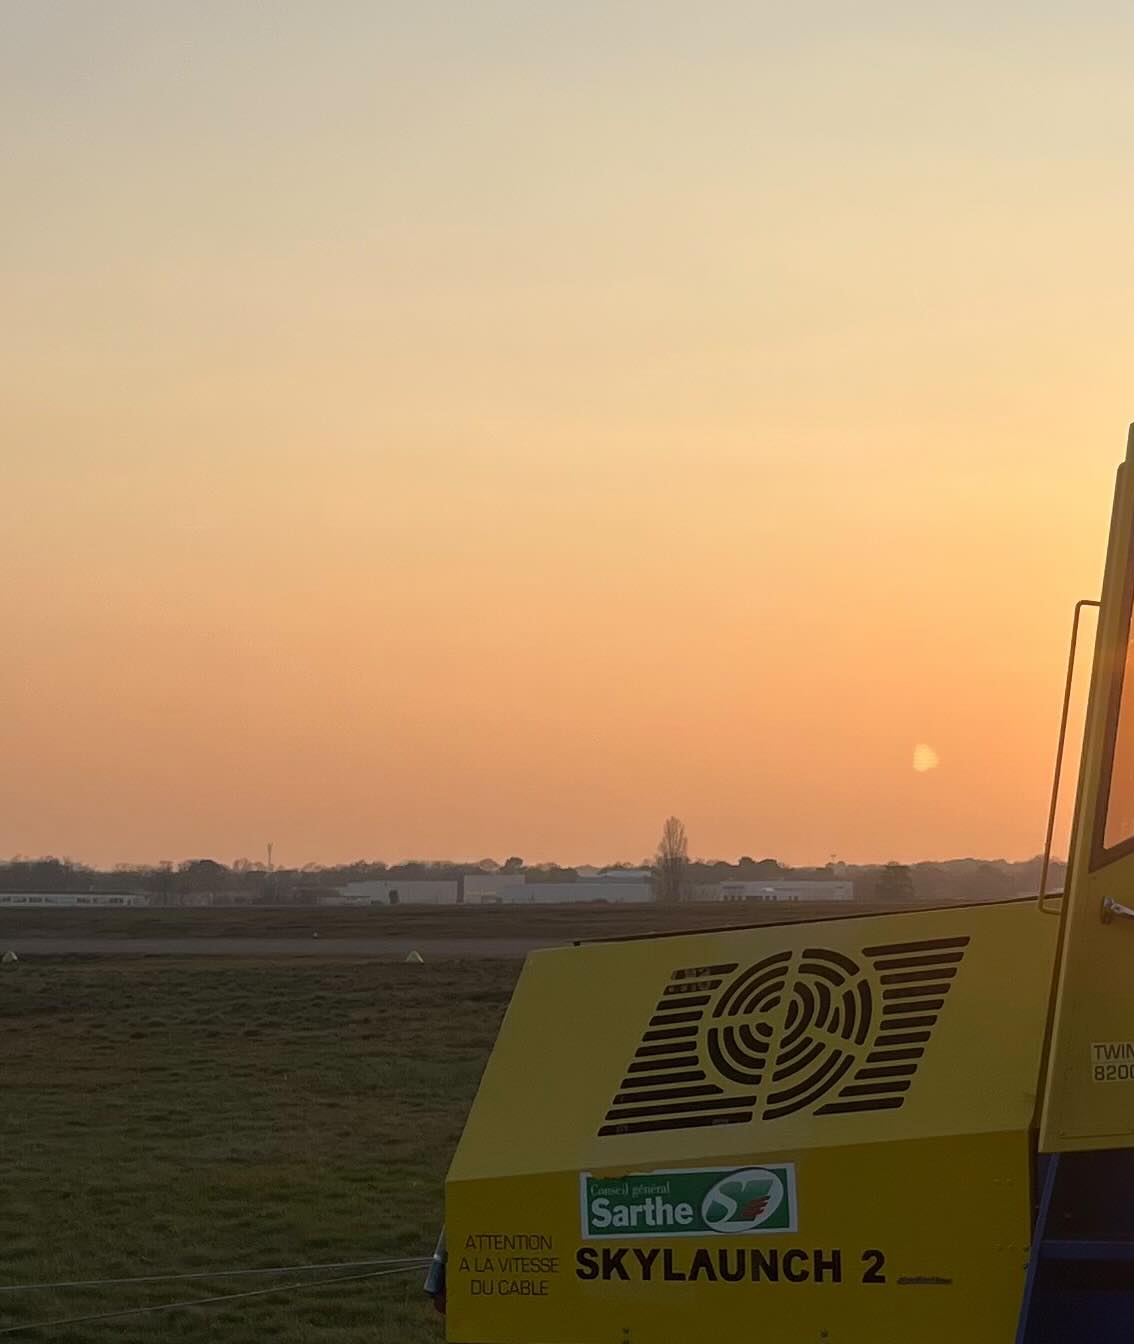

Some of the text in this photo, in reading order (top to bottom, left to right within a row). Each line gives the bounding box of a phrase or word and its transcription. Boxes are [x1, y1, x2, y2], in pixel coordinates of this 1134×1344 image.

[590, 1181, 671, 1198] Conseil général
[591, 1196, 694, 1228] Sarthe
[465, 1234, 553, 1251] ATTENTION
[458, 1257, 560, 1273] A LA VITESSE
[575, 1247, 886, 1284] SKYLAUNCH 2
[471, 1280, 549, 1296] DU CABLE
